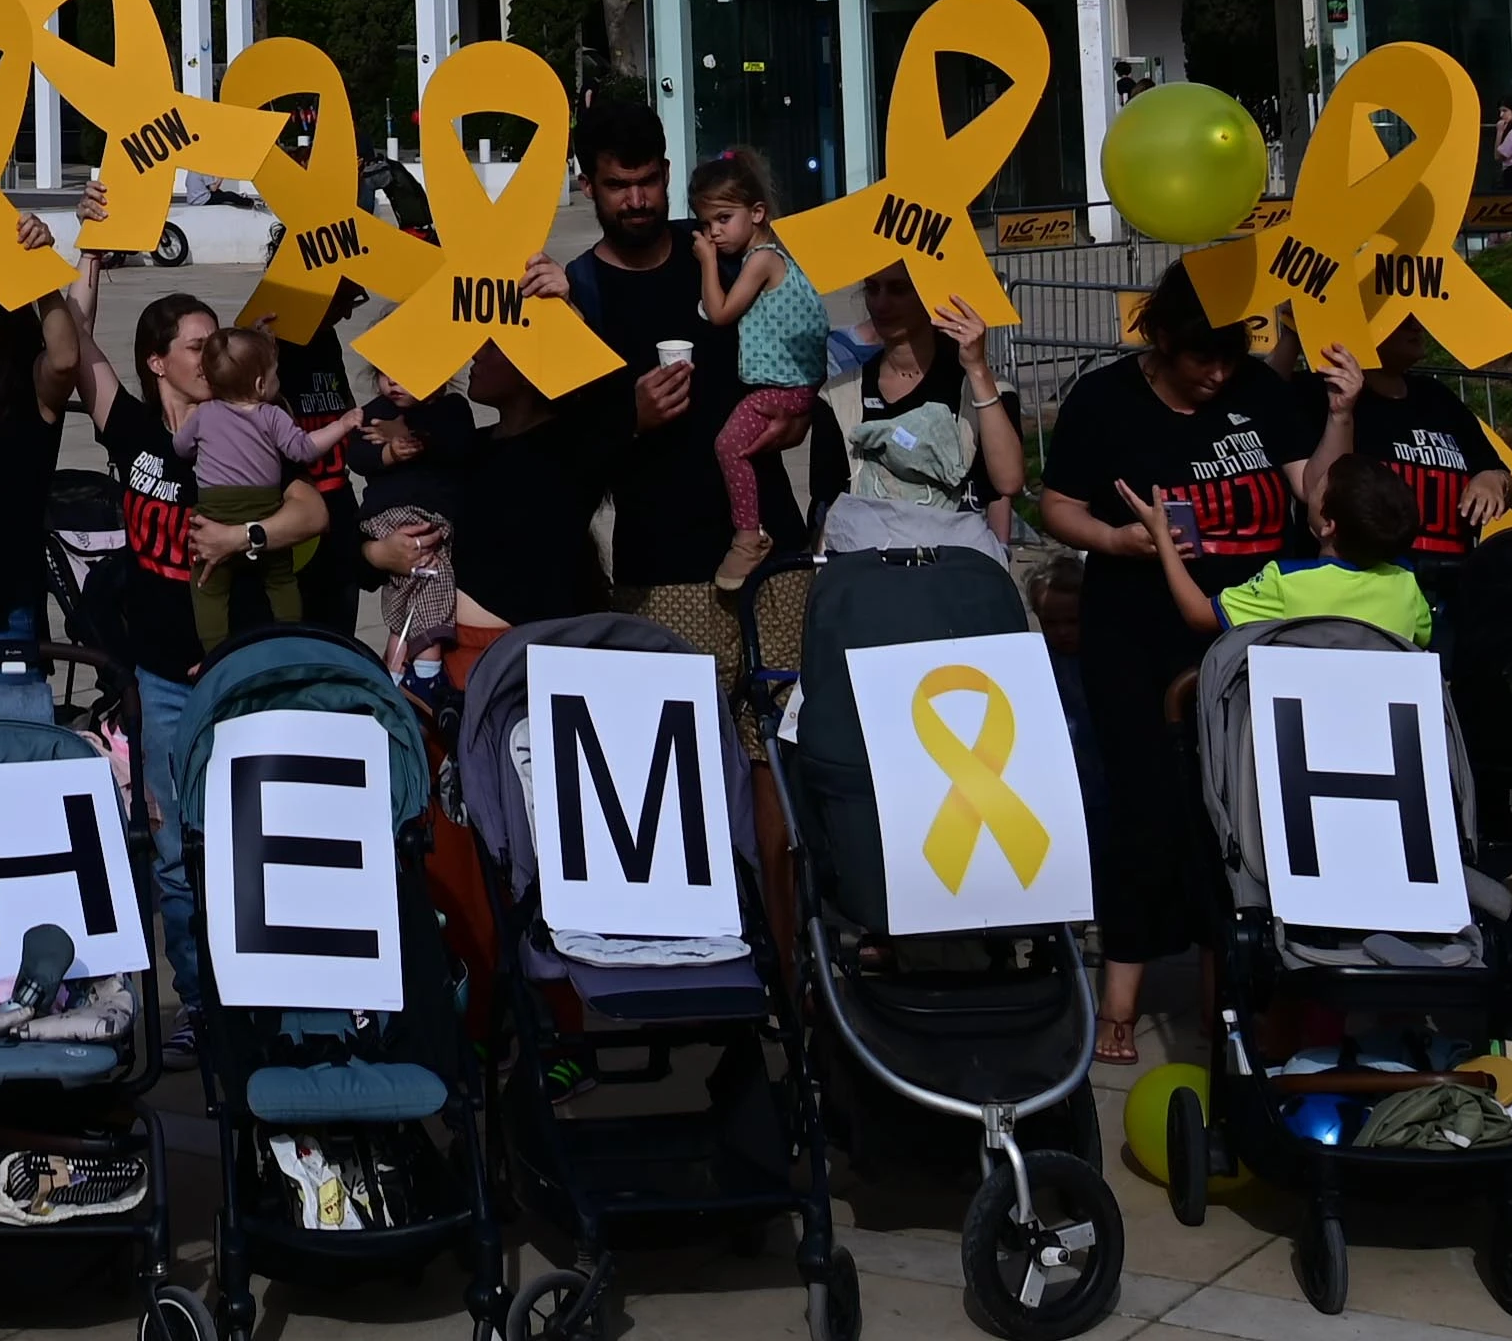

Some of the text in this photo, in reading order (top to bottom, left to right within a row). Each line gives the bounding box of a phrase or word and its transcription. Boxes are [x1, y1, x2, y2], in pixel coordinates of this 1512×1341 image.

[120, 108, 200, 175] NOW.
[295, 218, 369, 272] NOW.
[873, 194, 953, 261] NOW.
[1269, 236, 1341, 304] NOW.
[1375, 253, 1449, 300] NOW.
[452, 276, 530, 328] NOW.
[133, 450, 164, 479] BRING
